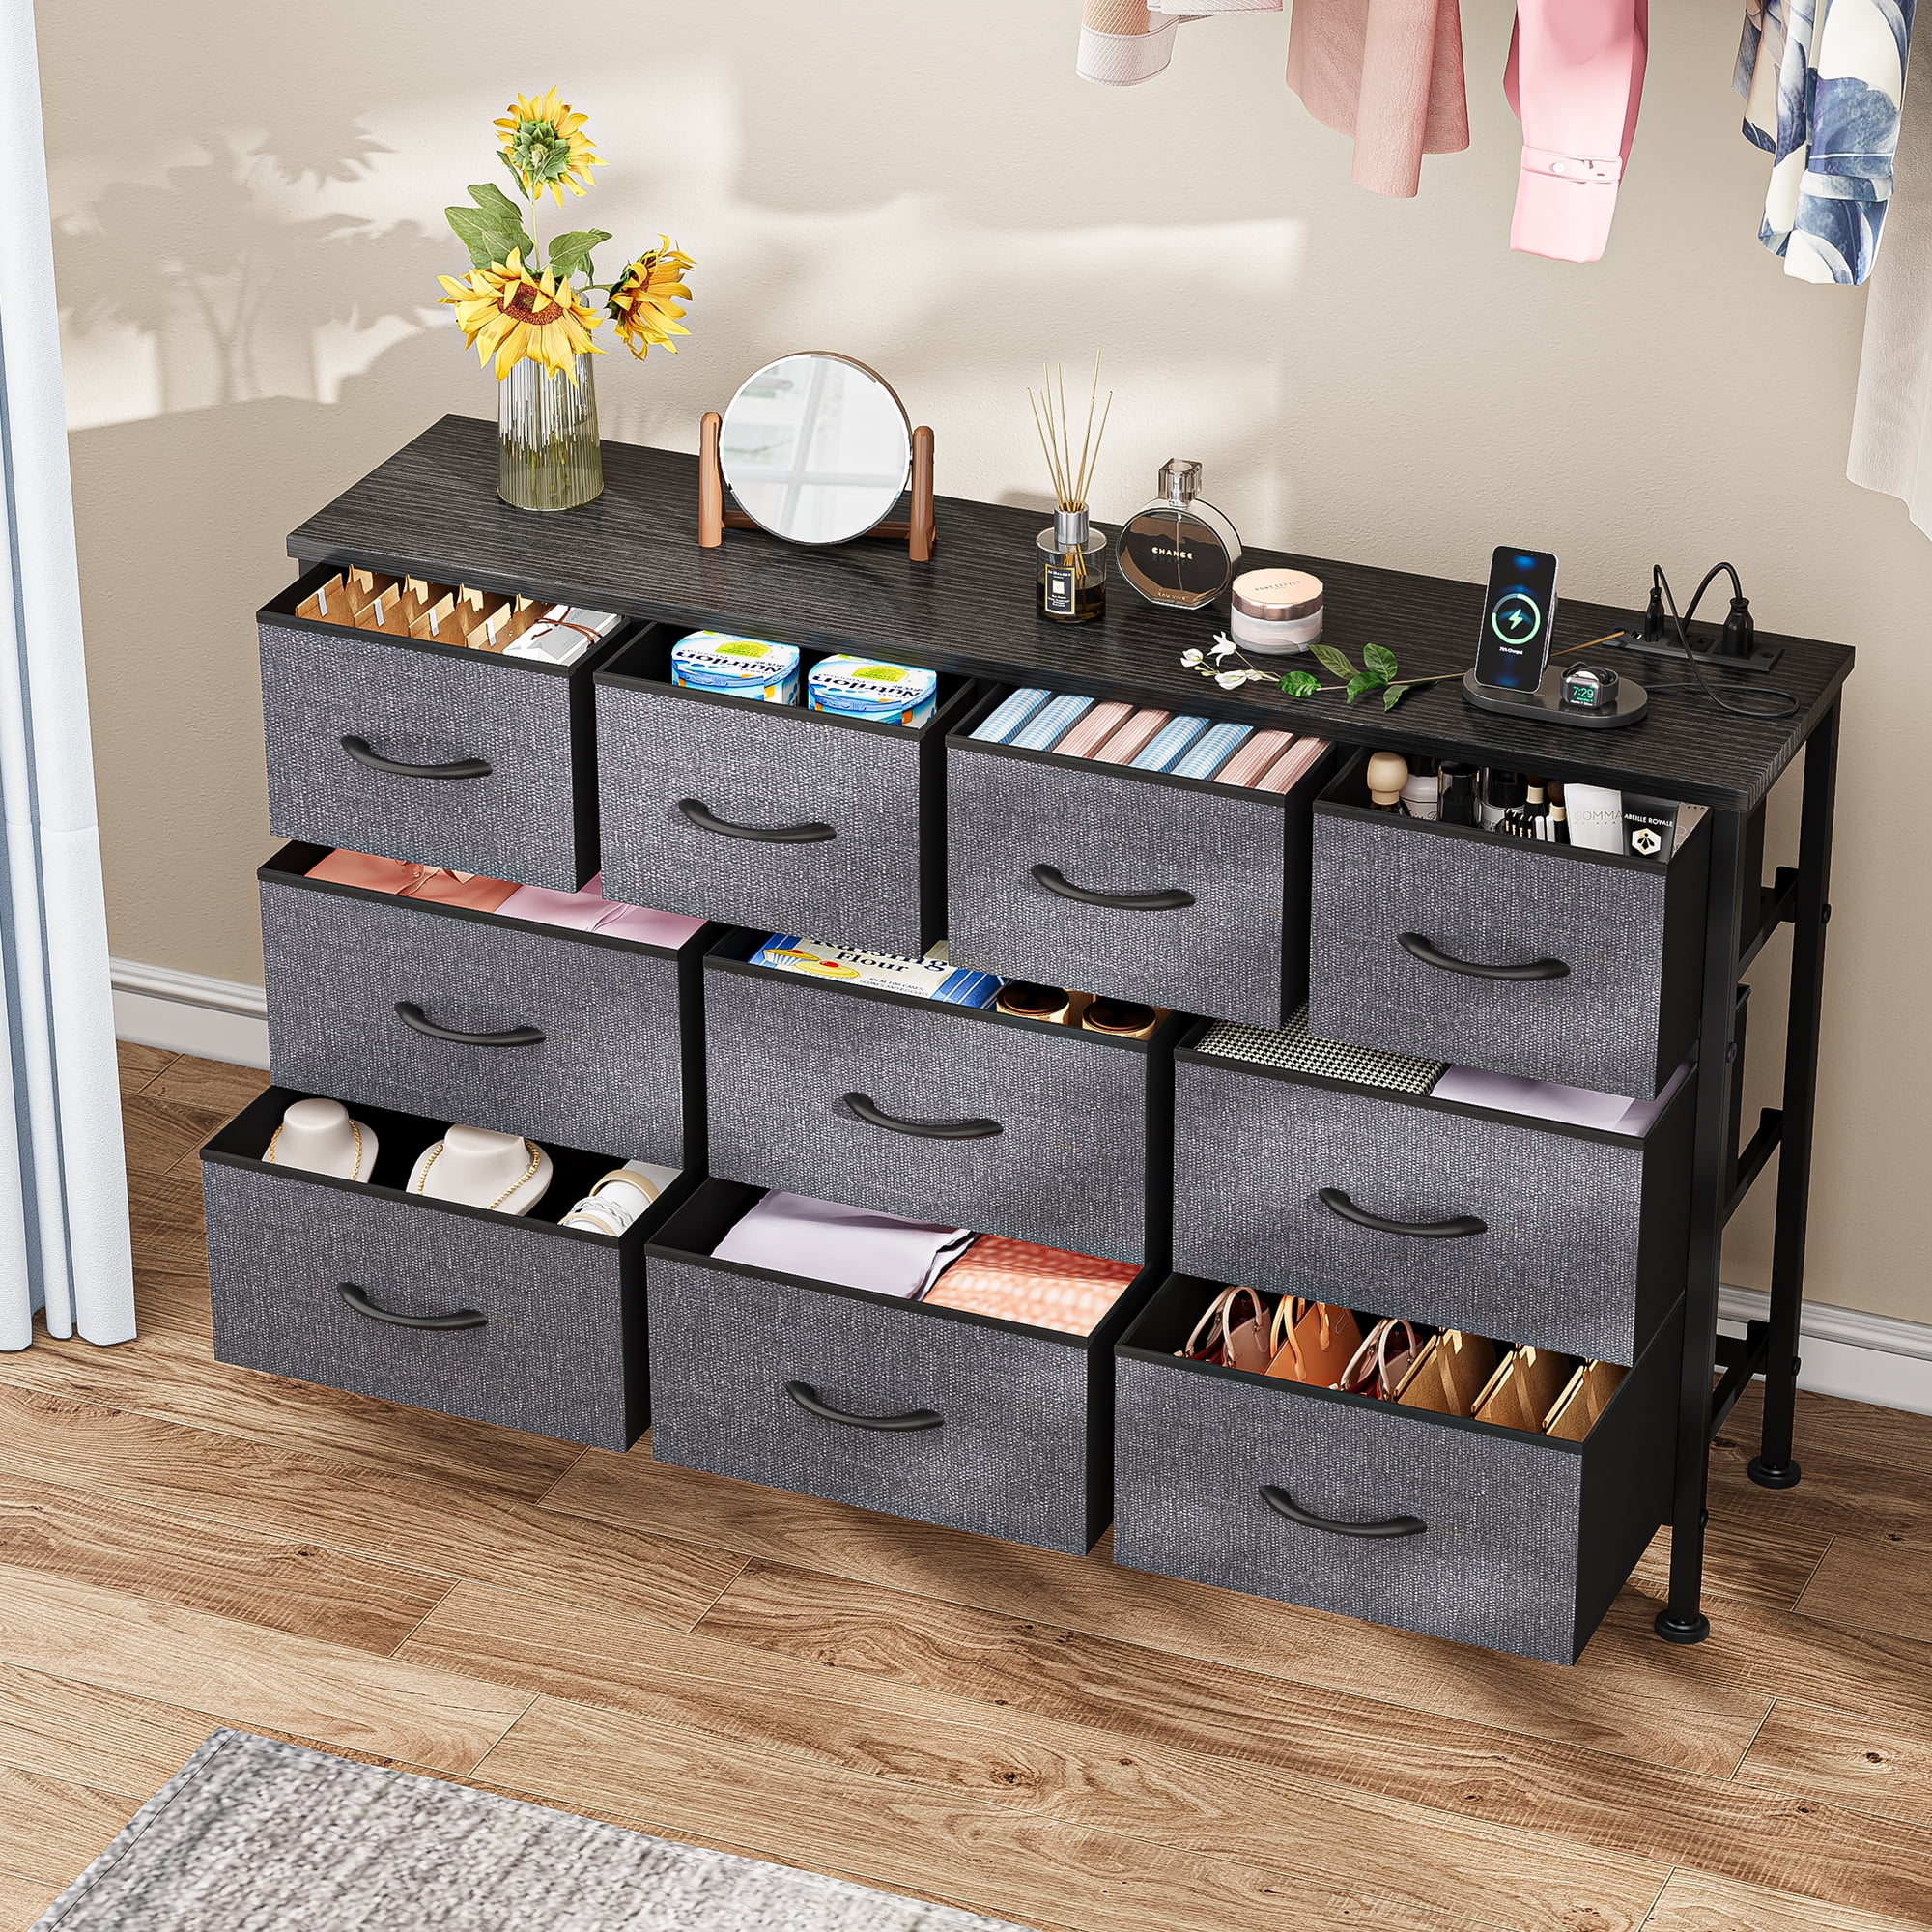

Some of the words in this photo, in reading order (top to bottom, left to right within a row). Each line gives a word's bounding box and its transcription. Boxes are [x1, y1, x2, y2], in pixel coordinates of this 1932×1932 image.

[1151, 547, 1193, 560] CHANCE
[675, 651, 782, 673] Nutrilon
[811, 675, 920, 697] Nutrilon
[1573, 686, 1594, 698] 7:29
[1624, 813, 1647, 824] ABEILLE
[1648, 817, 1674, 828] ROYALE
[835, 952, 909, 973] Flour
